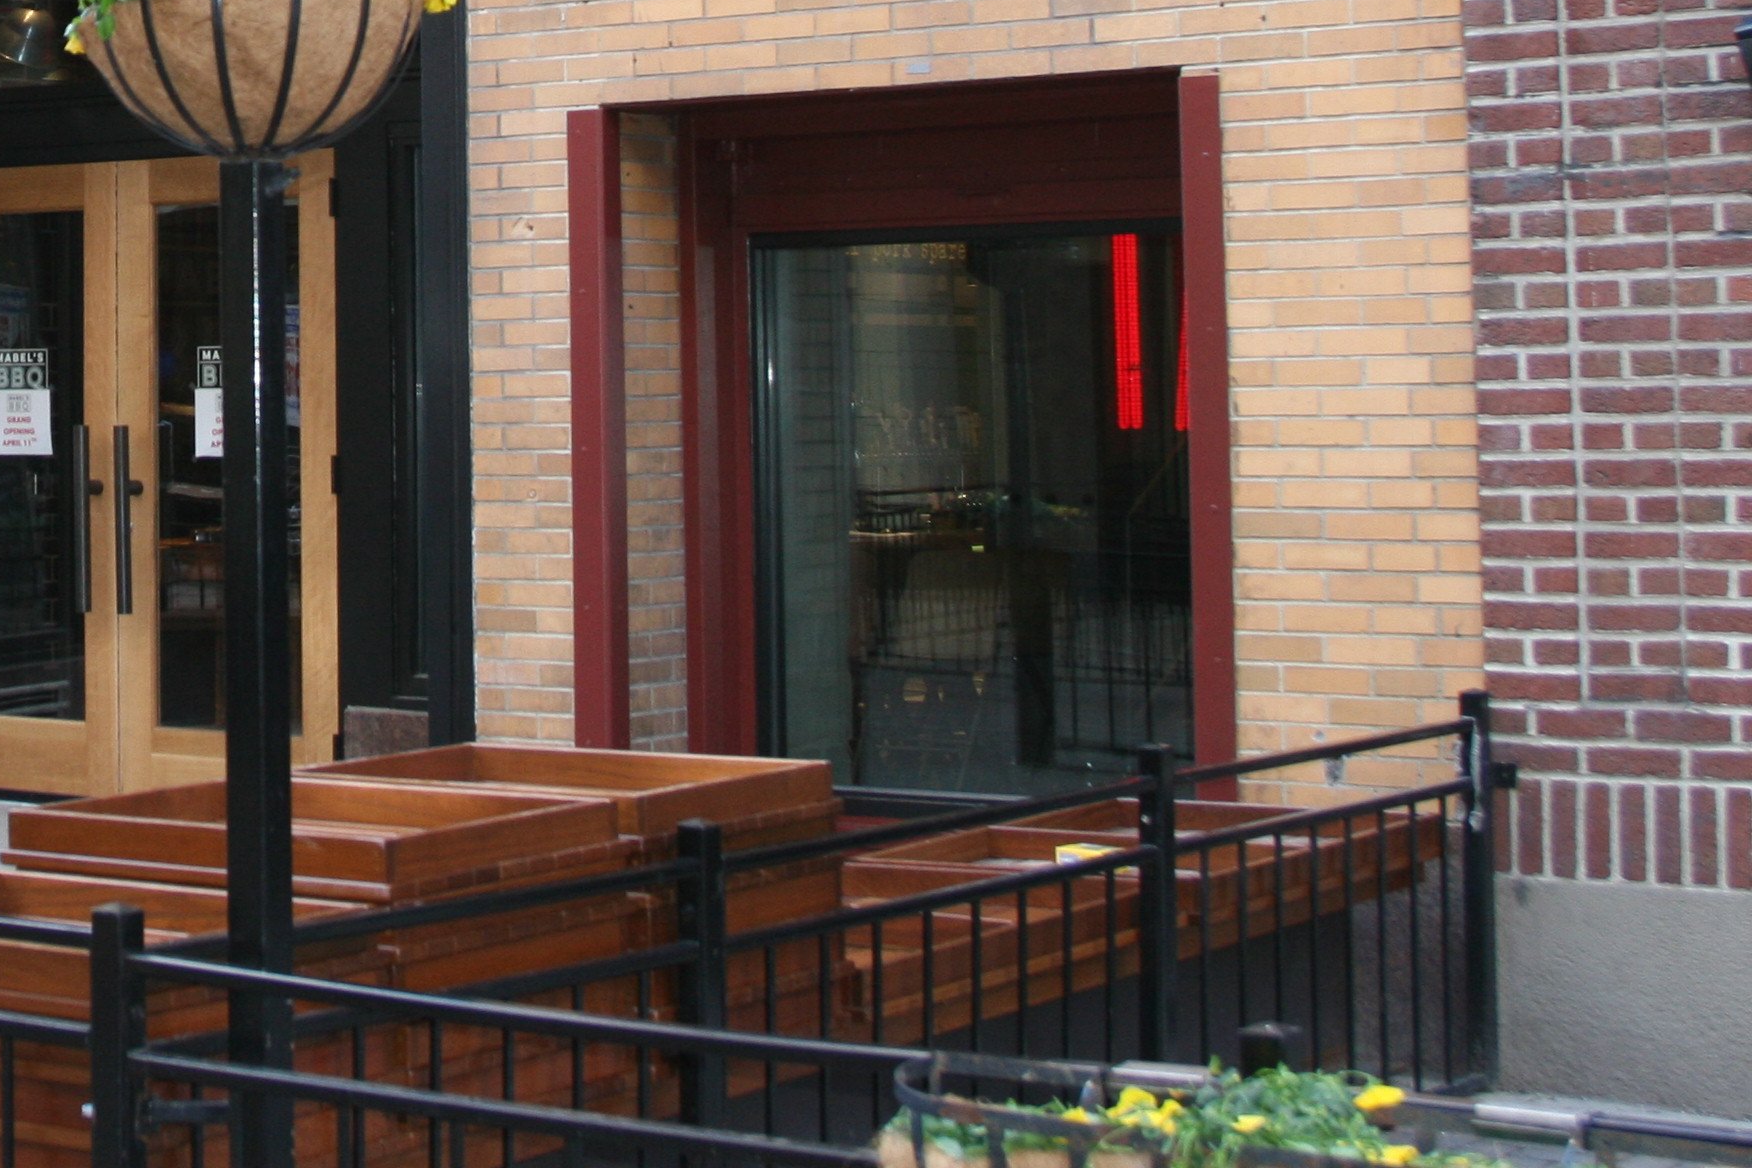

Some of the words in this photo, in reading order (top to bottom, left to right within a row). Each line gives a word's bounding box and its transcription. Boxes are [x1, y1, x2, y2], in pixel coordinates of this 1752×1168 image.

[201, 364, 223, 387] B
[6, 416, 32, 424] GRAND
[2, 439, 21, 447] APRIL
